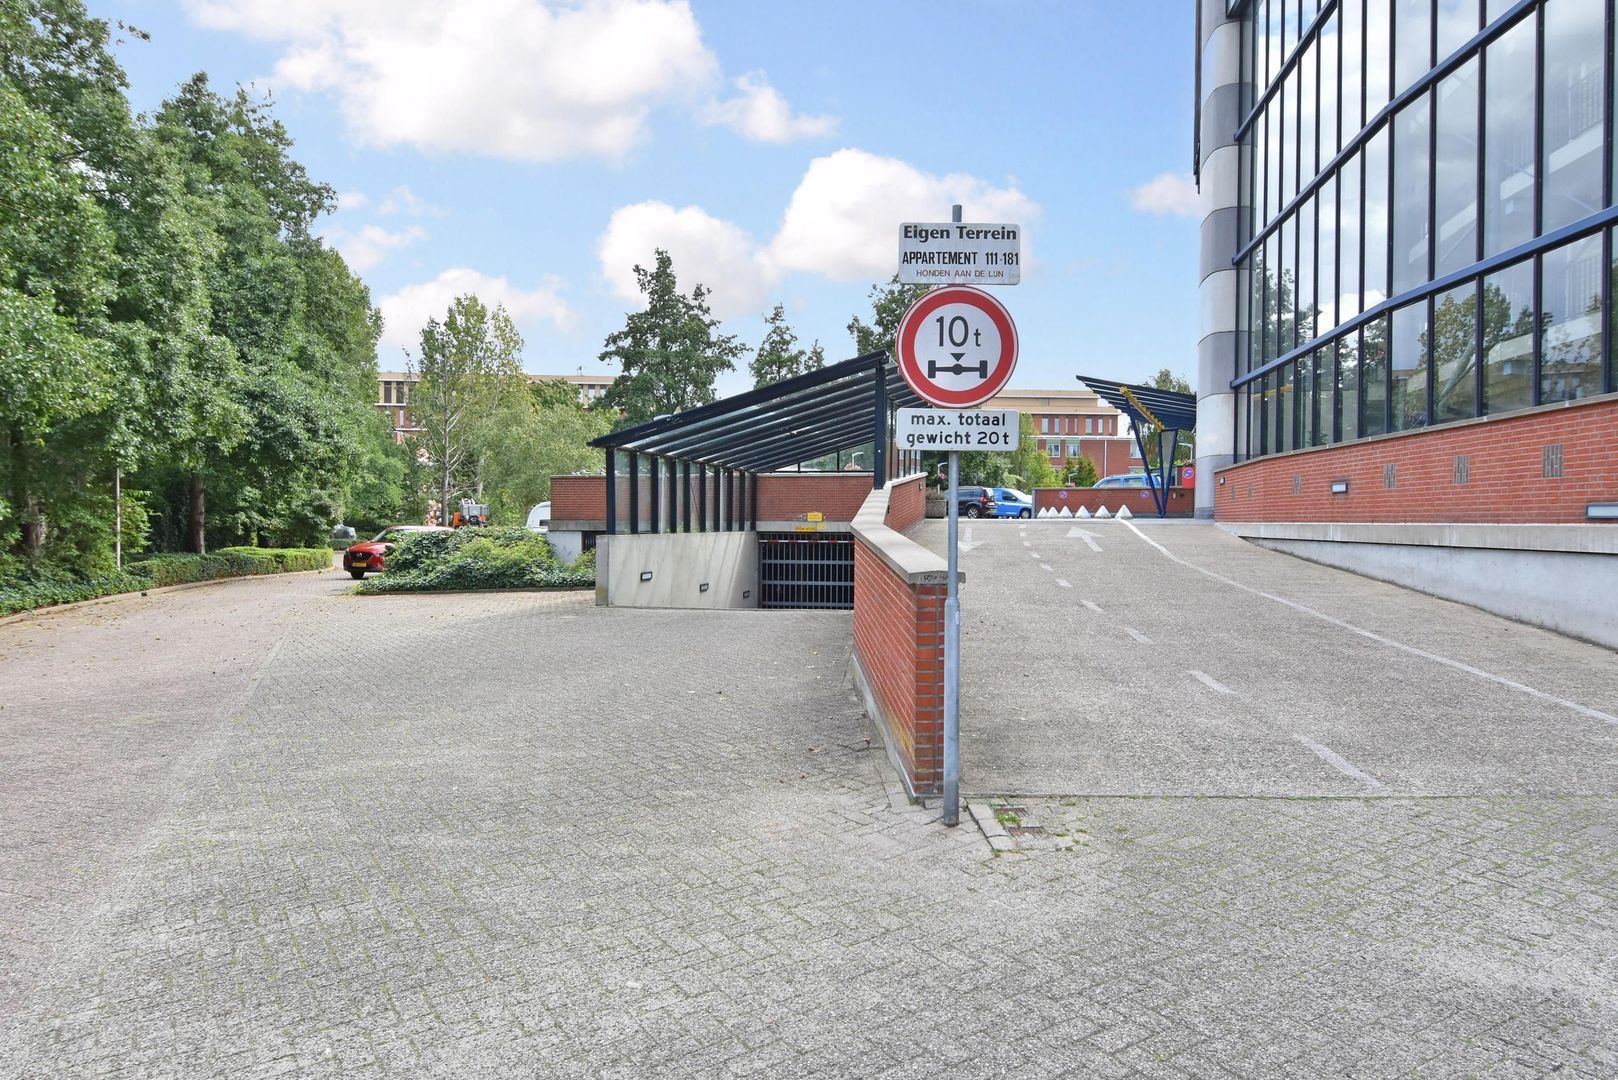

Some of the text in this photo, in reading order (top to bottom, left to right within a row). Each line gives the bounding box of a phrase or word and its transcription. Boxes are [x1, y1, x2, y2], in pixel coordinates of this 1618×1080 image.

[903, 225, 1017, 242] Eigen Terrein
[902, 251, 1019, 265] APPARTEMENT 111-181
[911, 413, 1006, 426] max. totaal
[906, 431, 971, 447] gewicht
